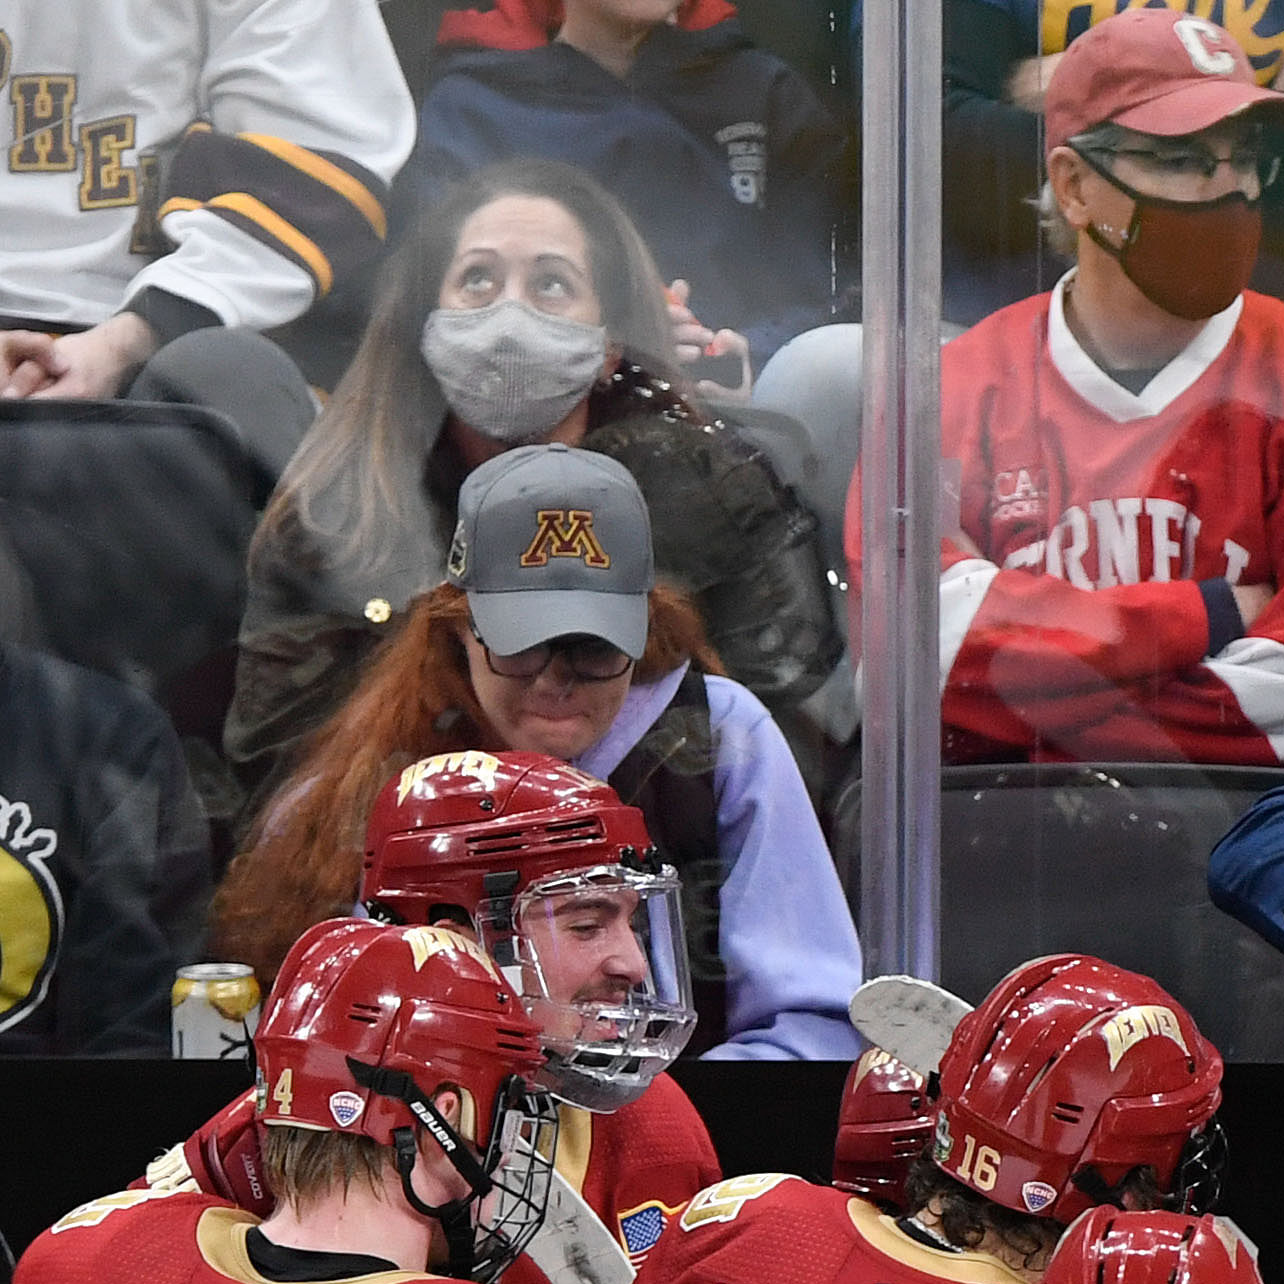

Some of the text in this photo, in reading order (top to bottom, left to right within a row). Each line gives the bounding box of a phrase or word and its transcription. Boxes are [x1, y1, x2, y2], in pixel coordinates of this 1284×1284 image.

[1173, 19, 1236, 75] C
[520, 509, 610, 569] M
[273, 1068, 294, 1115] 4
[410, 1101, 457, 1152] BAUER
[241, 1153, 264, 1200] COVERT
[956, 1134, 1002, 1191] 16
